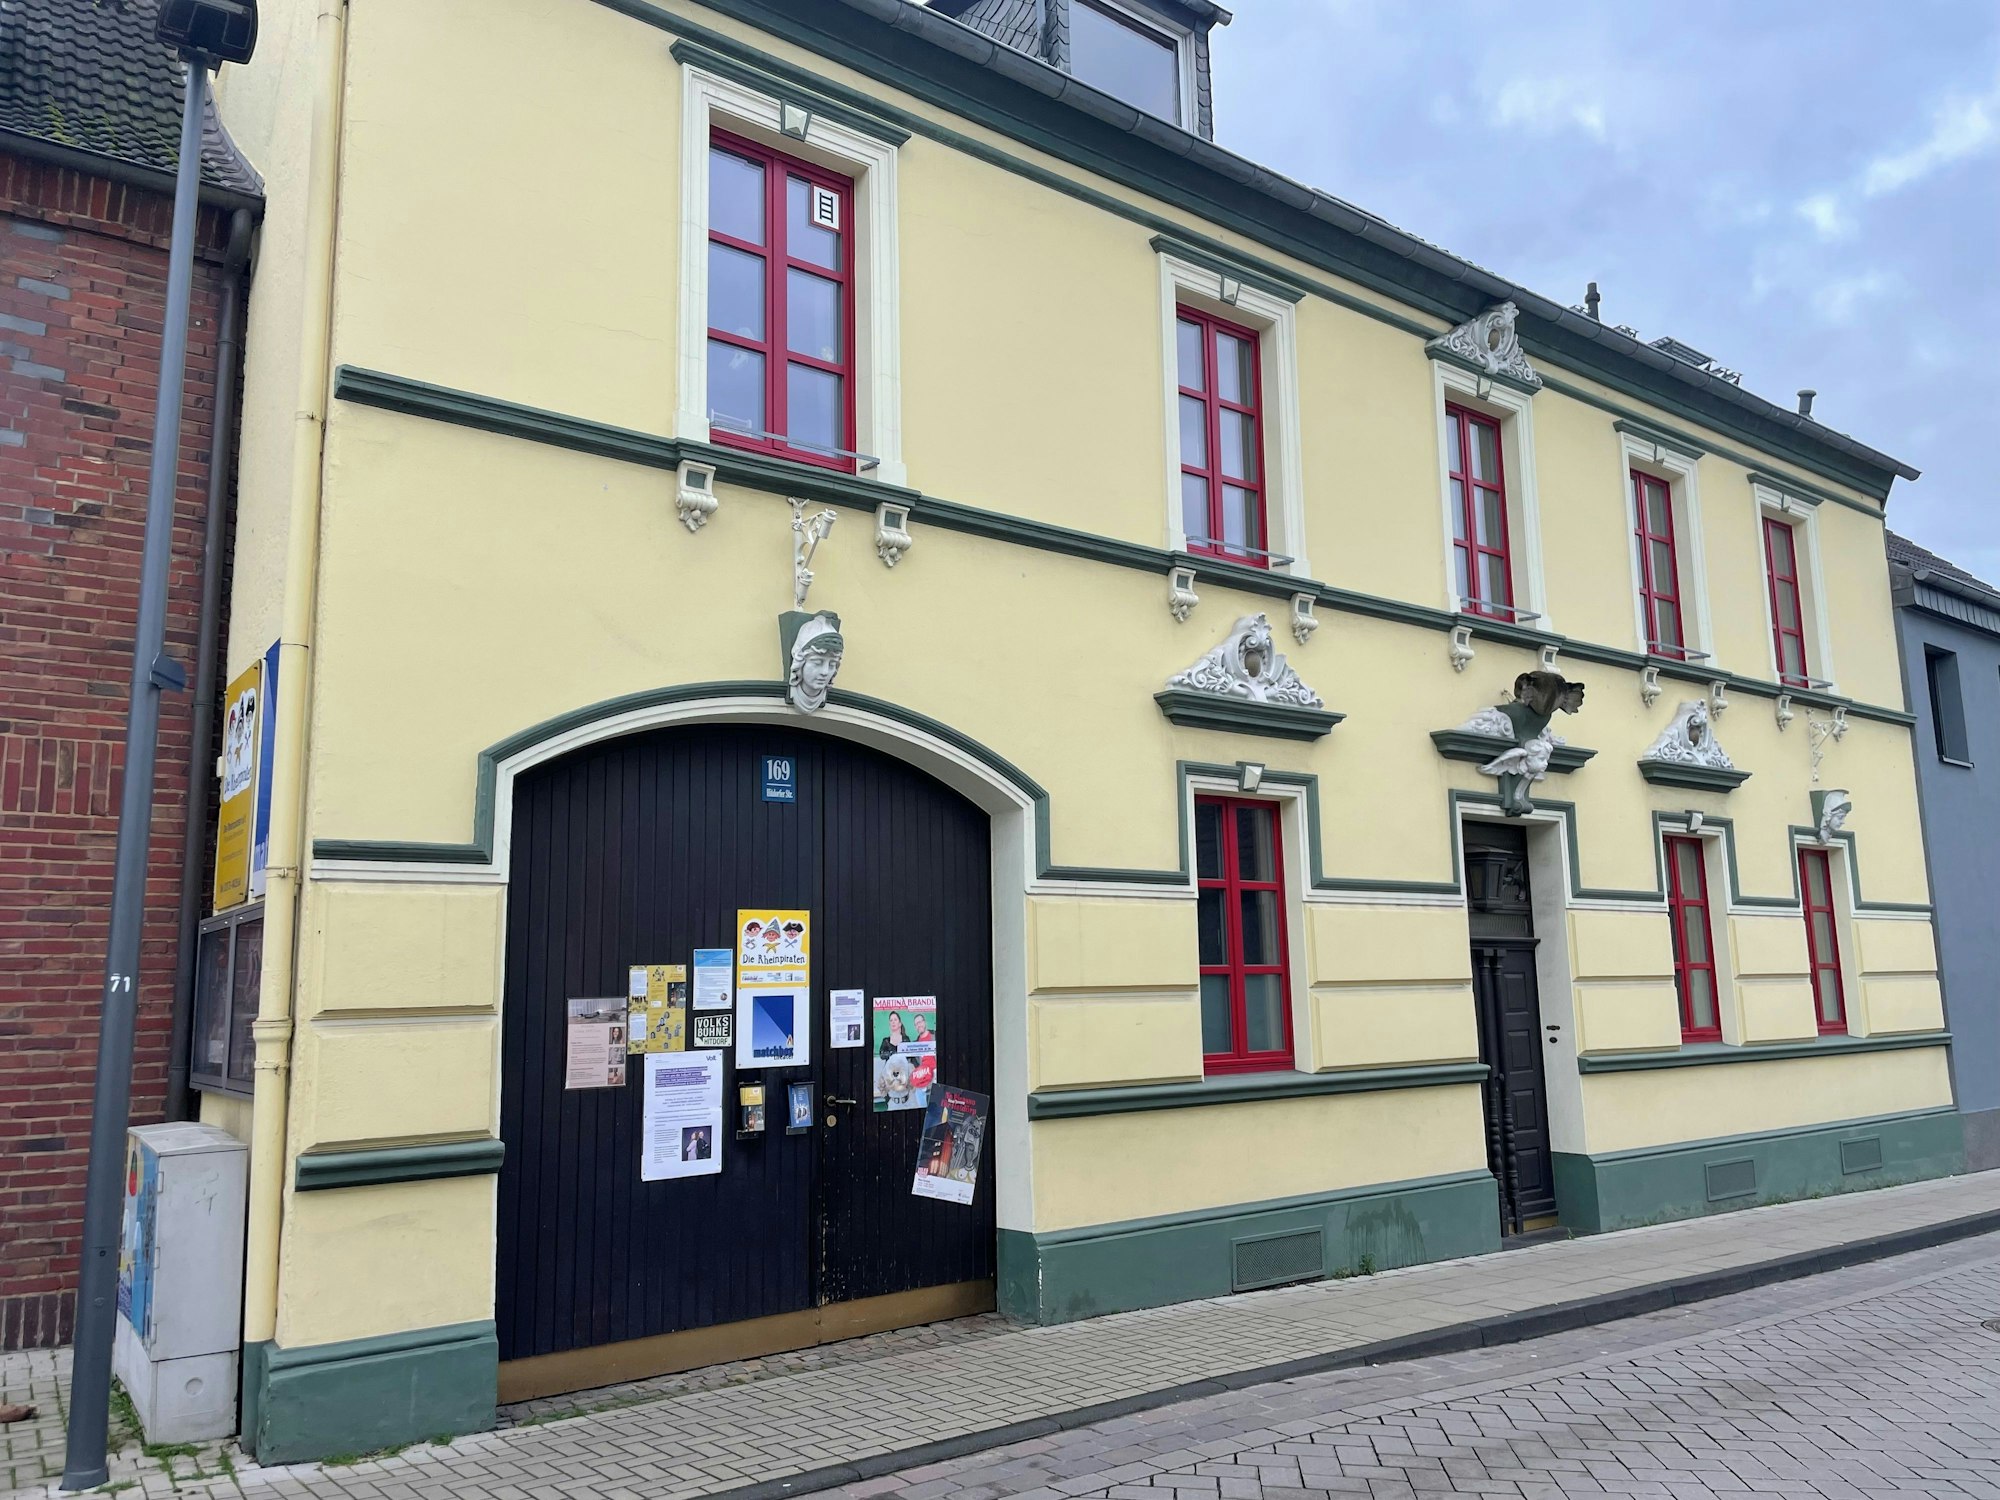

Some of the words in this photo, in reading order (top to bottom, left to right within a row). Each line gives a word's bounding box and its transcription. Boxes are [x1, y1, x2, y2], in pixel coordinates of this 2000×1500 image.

[766, 760, 791, 781] 169
[742, 953, 755, 964] Die
[757, 954, 806, 964] Rheinpiraten
[110, 973, 131, 993] 71
[875, 998, 906, 1007] MARTINA
[907, 997, 935, 1006] BRANDL
[697, 1016, 729, 1028] VOLKS
[704, 1037, 728, 1045] HITDORF
[753, 1046, 794, 1058] matchbox
